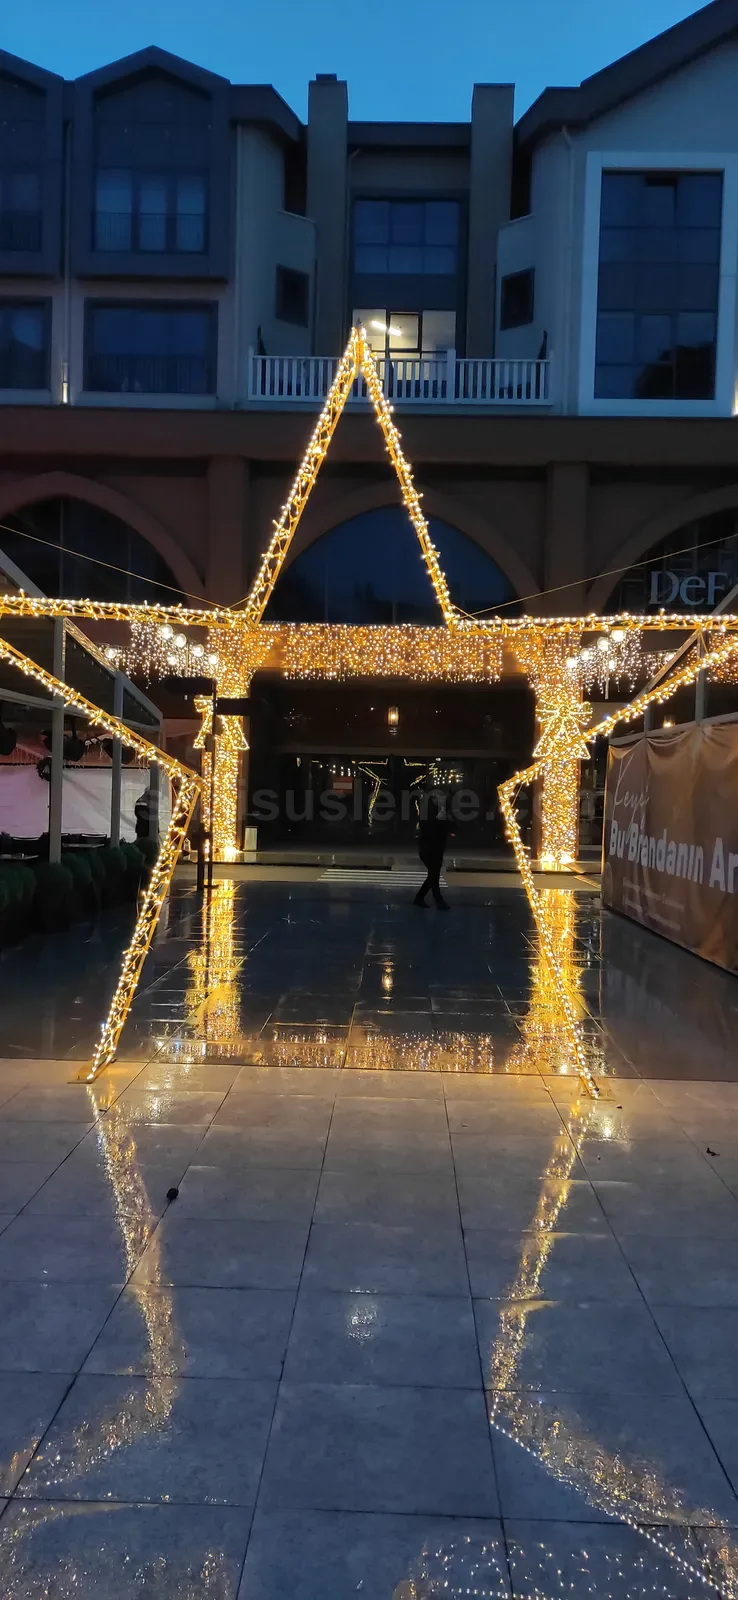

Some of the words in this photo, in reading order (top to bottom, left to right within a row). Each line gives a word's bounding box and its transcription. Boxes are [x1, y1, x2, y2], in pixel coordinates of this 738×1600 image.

[649, 571, 728, 606] DeF
[609, 820, 626, 858] Bu
[627, 822, 704, 884] Brandanın
